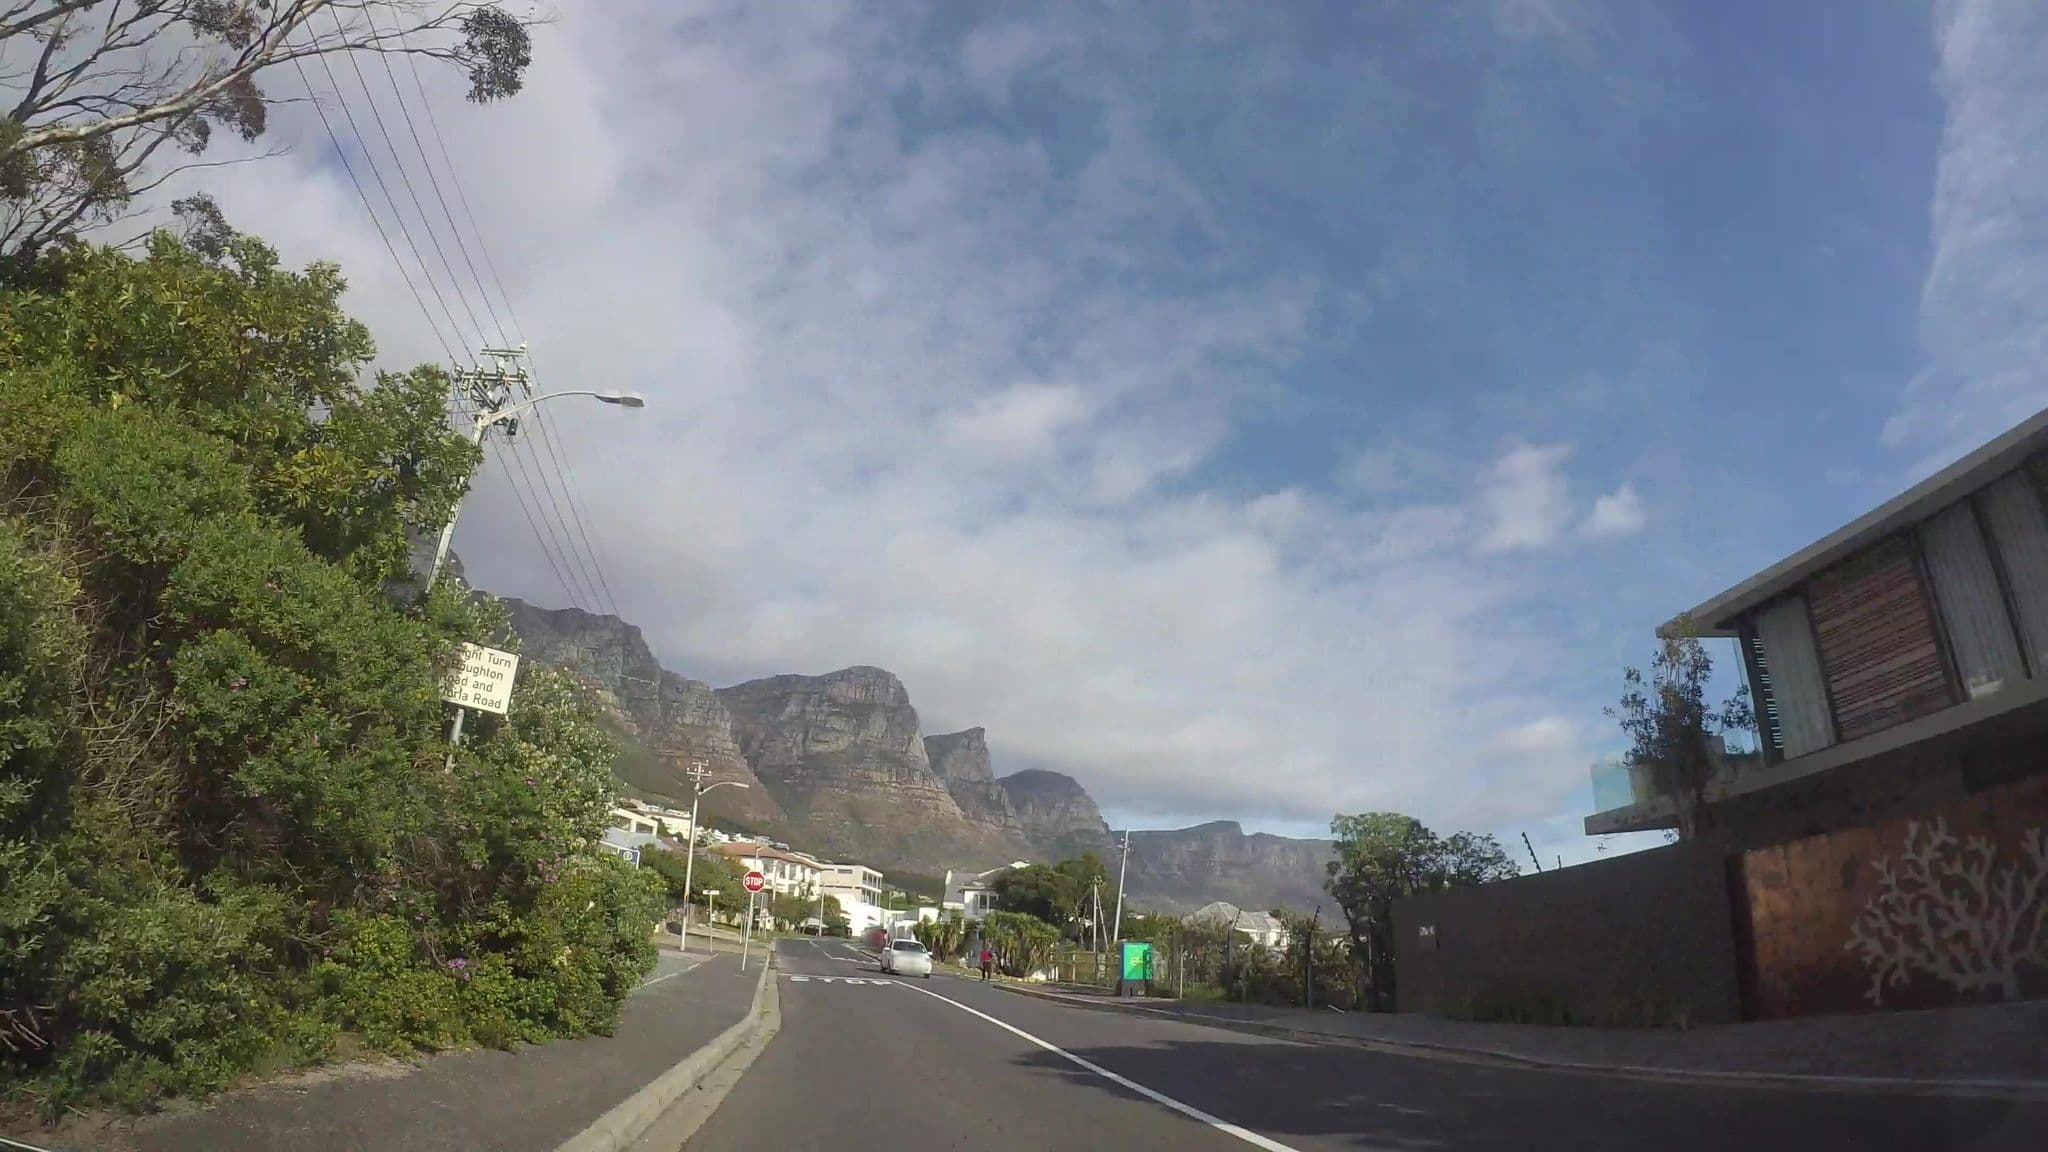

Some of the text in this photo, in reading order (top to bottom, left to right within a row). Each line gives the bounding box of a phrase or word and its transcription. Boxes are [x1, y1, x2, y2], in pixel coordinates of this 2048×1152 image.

[488, 652, 511, 668] Turn
[439, 671, 494, 693] Road and
[473, 693, 502, 709] Road
[745, 877, 763, 886] STOP
